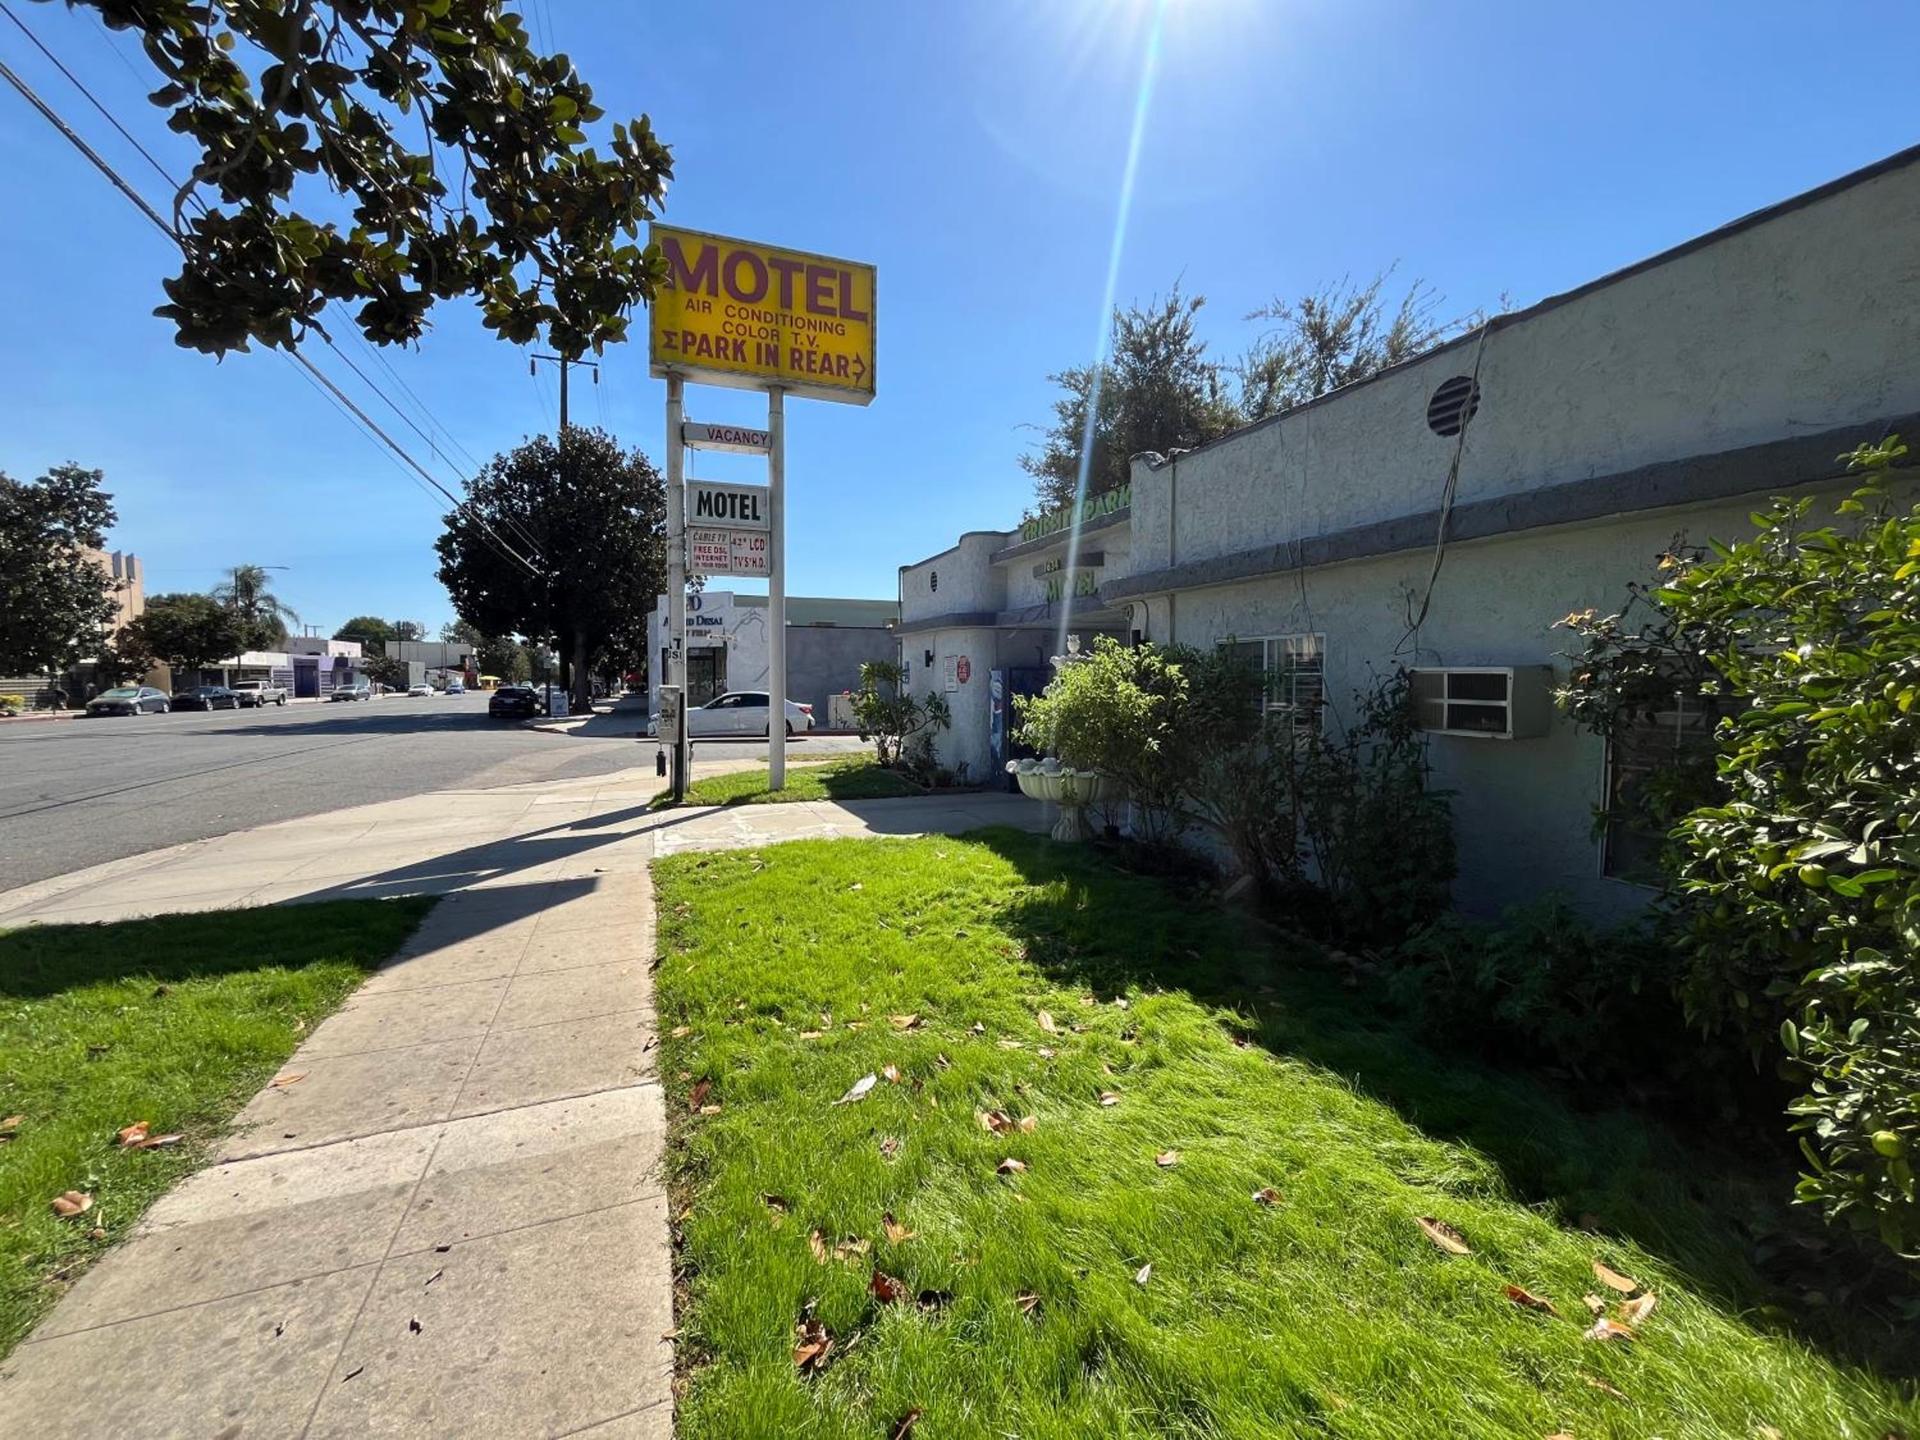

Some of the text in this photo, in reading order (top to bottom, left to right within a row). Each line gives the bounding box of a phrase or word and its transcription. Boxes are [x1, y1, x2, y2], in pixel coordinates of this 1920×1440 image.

[661, 236, 868, 323] MOTEL
[685, 298, 846, 336] AIR CONDITIONING
[722, 320, 820, 348] COLOR T.V.
[682, 330, 850, 378] PARK IN REAR
[707, 427, 769, 446] VACANCY
[696, 490, 761, 521] MOTEL
[1083, 483, 1131, 522] PARK
[749, 537, 765, 551] LCD
